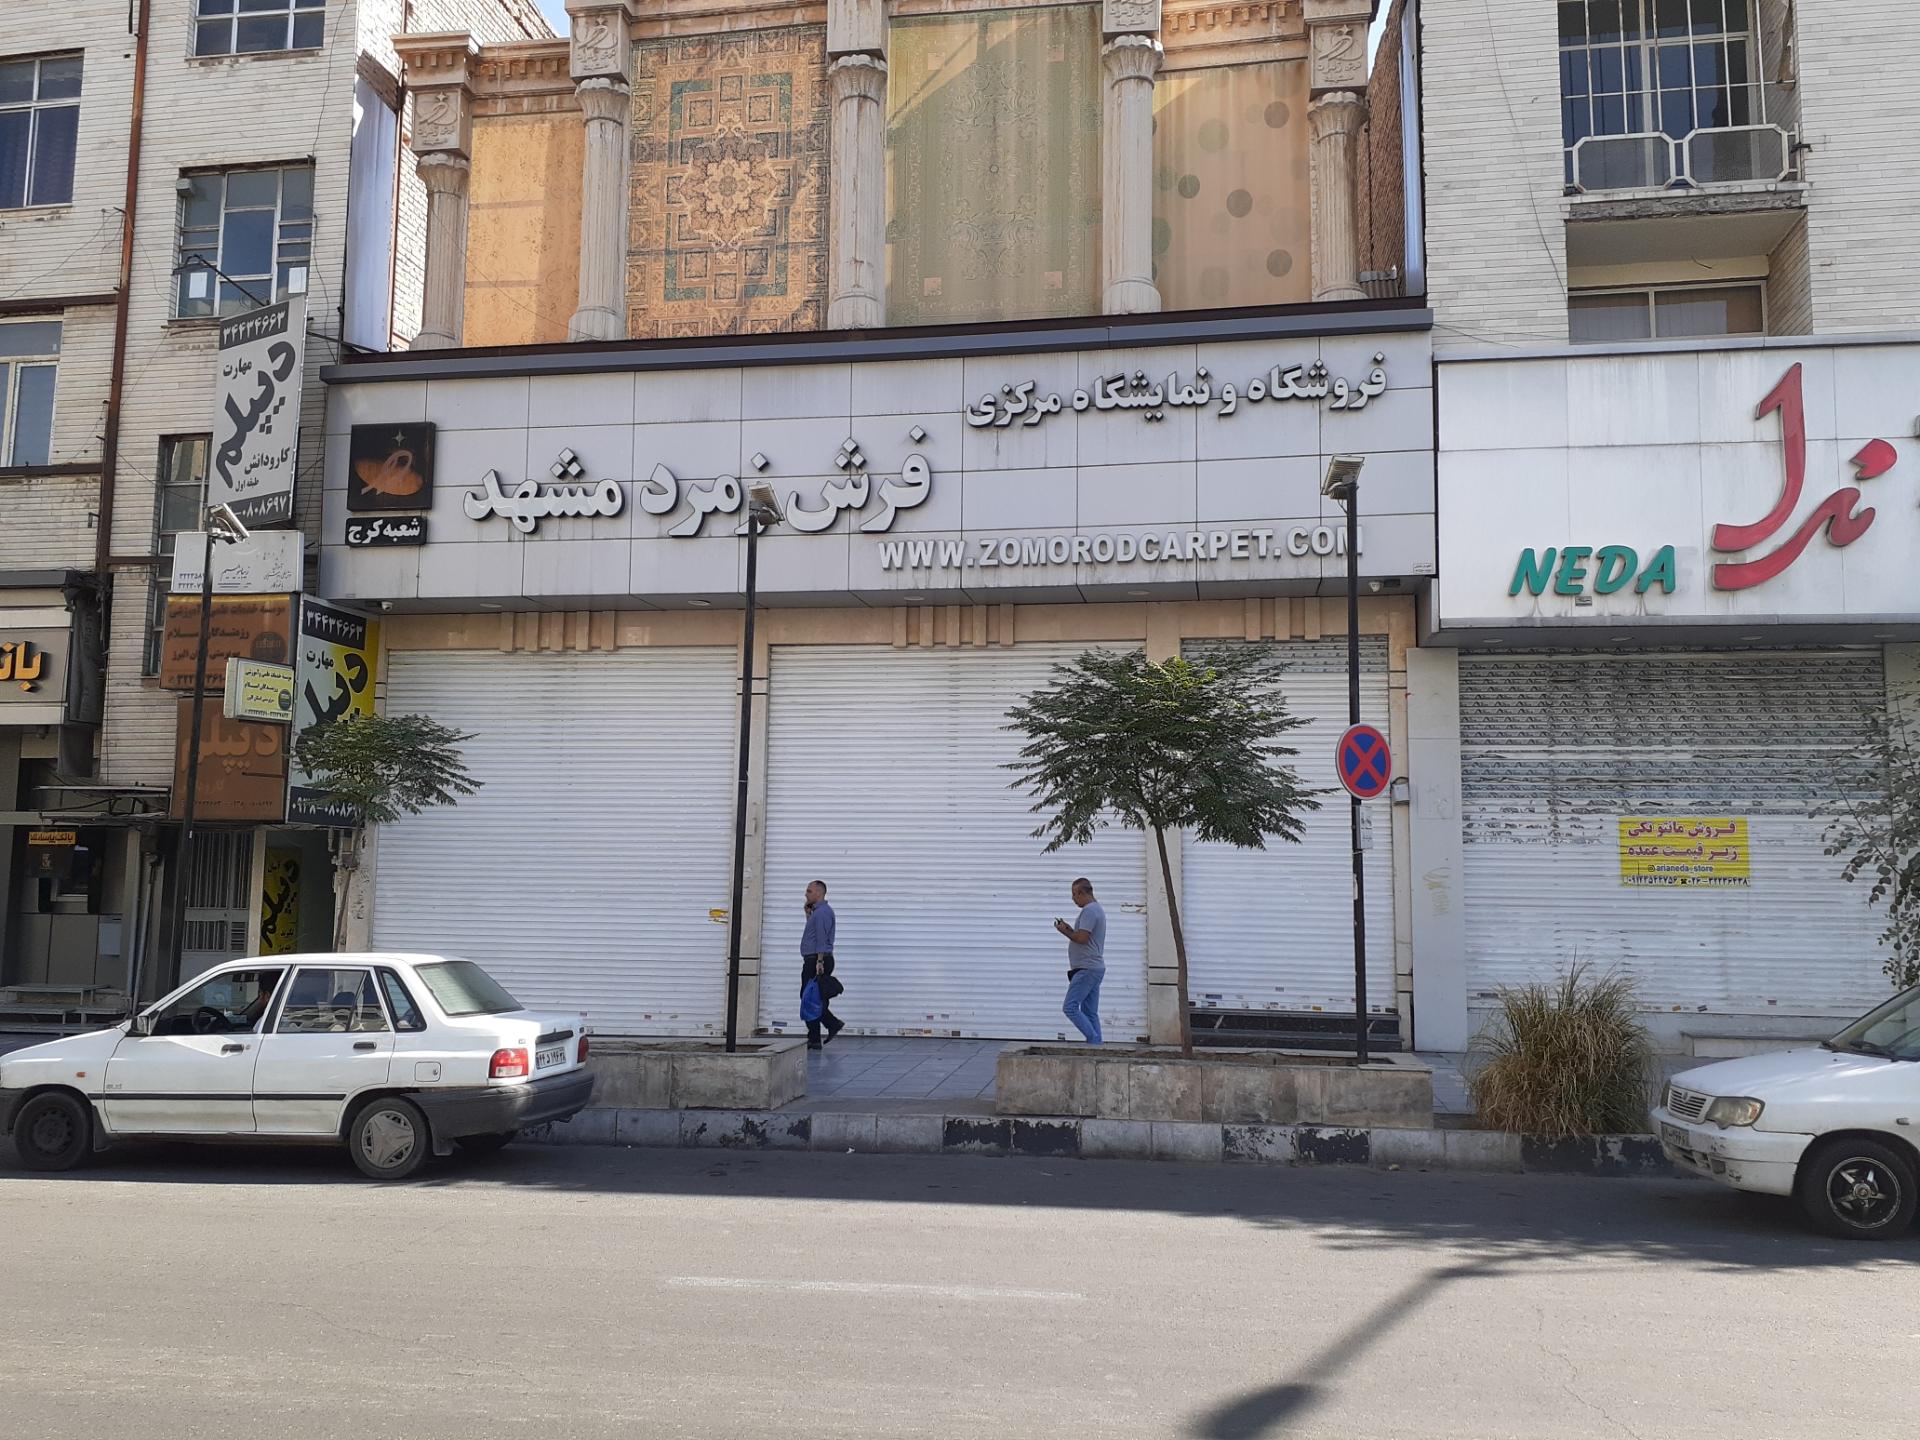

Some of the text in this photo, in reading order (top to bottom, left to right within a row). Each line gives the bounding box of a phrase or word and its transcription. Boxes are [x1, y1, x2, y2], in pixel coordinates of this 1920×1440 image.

[222, 309, 286, 345] ۳۴۴۳۴۶۶۳
[222, 357, 252, 380] مهارت
[965, 351, 1388, 428] فروشگاه و نمایشگاه مرکزی
[216, 341, 296, 489] دیپلم
[235, 480, 246, 492] اول
[463, 446, 625, 535] مشهد
[785, 425, 932, 534] فرش
[1711, 361, 1898, 591] ندا
[348, 517, 421, 545] شعبه کرج
[878, 524, 1364, 570] WWW.ZOMORODCARPET.COM
[1508, 544, 1676, 597] NEDA
[306, 609, 363, 641] ۳۴۴۳۴۶۶۳
[0, 640, 44, 692] بان
[306, 650, 335, 671] مهارت
[293, 653, 369, 775] دیپل
[1627, 843, 1738, 861] زیر قیمت عمده
[1628, 820, 1736, 838] فروش مانتو تکی
